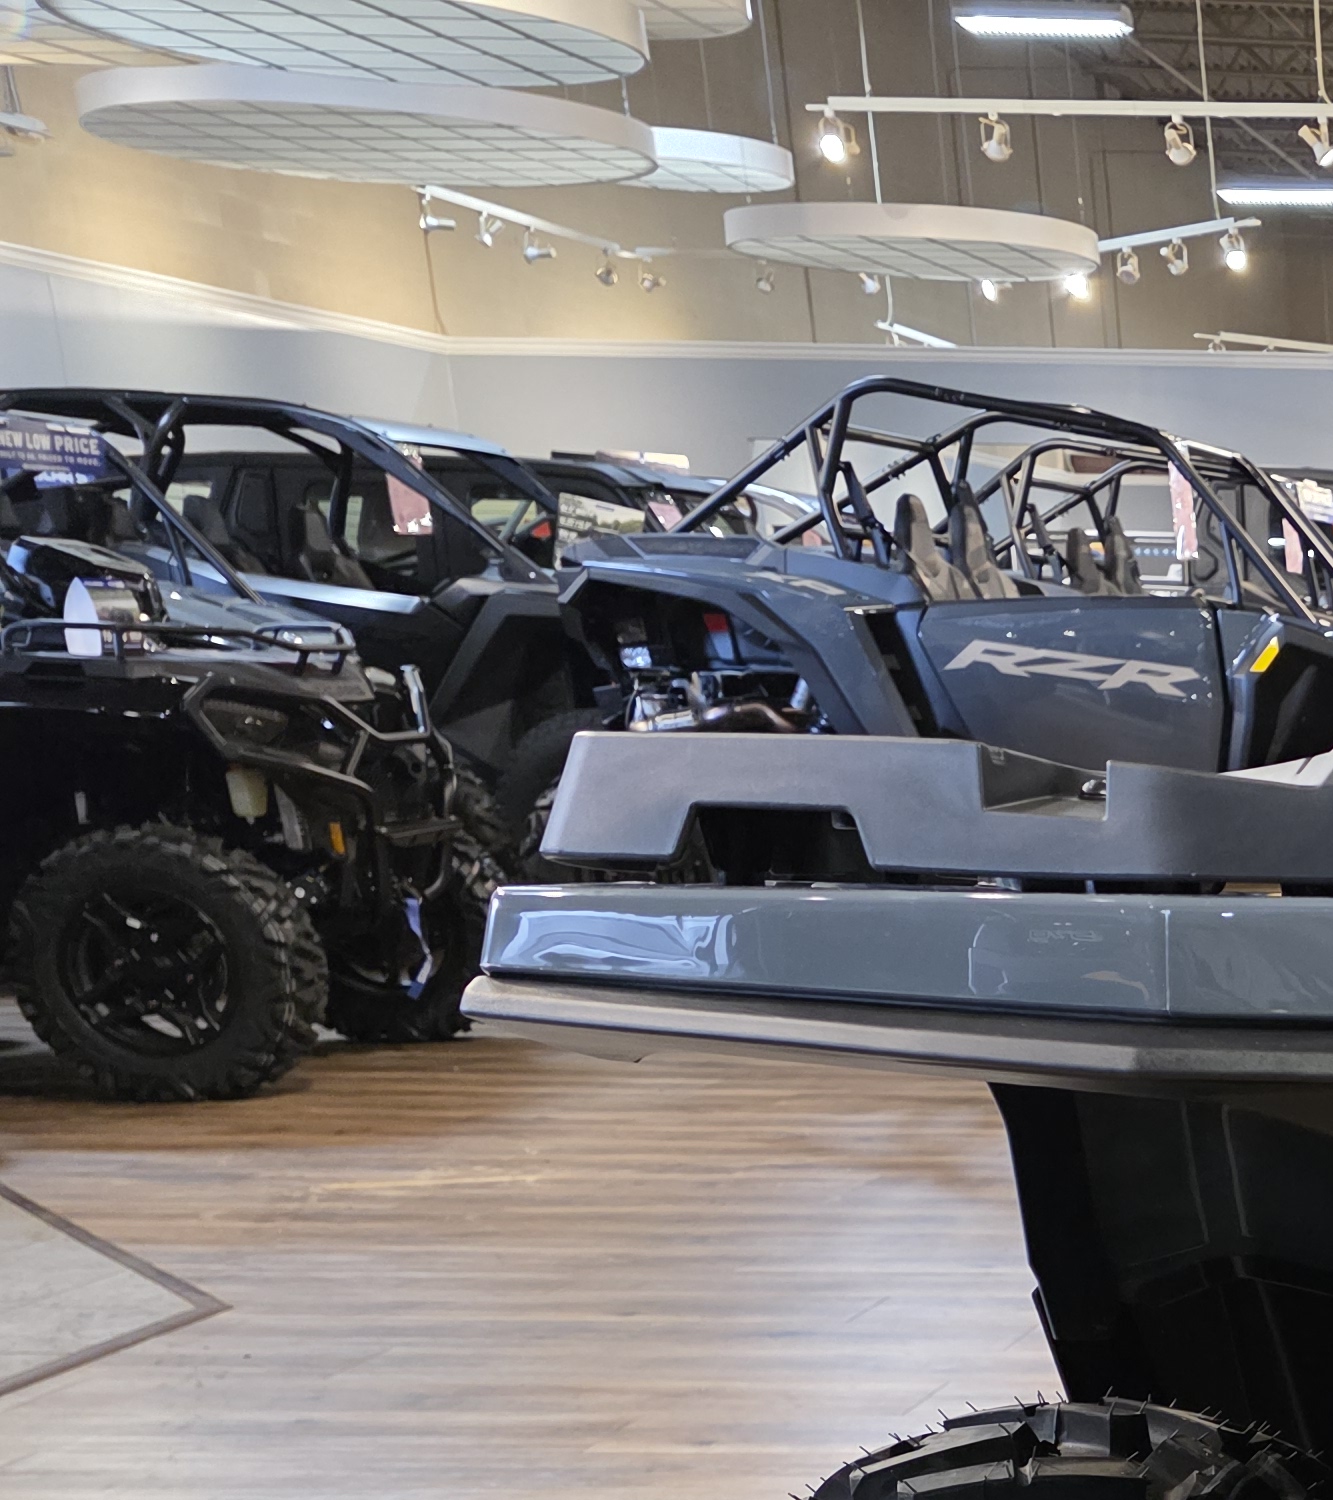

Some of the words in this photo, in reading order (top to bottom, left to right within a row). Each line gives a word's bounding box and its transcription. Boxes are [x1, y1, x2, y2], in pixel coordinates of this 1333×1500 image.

[25, 433, 51, 450] LOW
[54, 435, 100, 456] PRICE
[943, 639, 1200, 697] RZR
